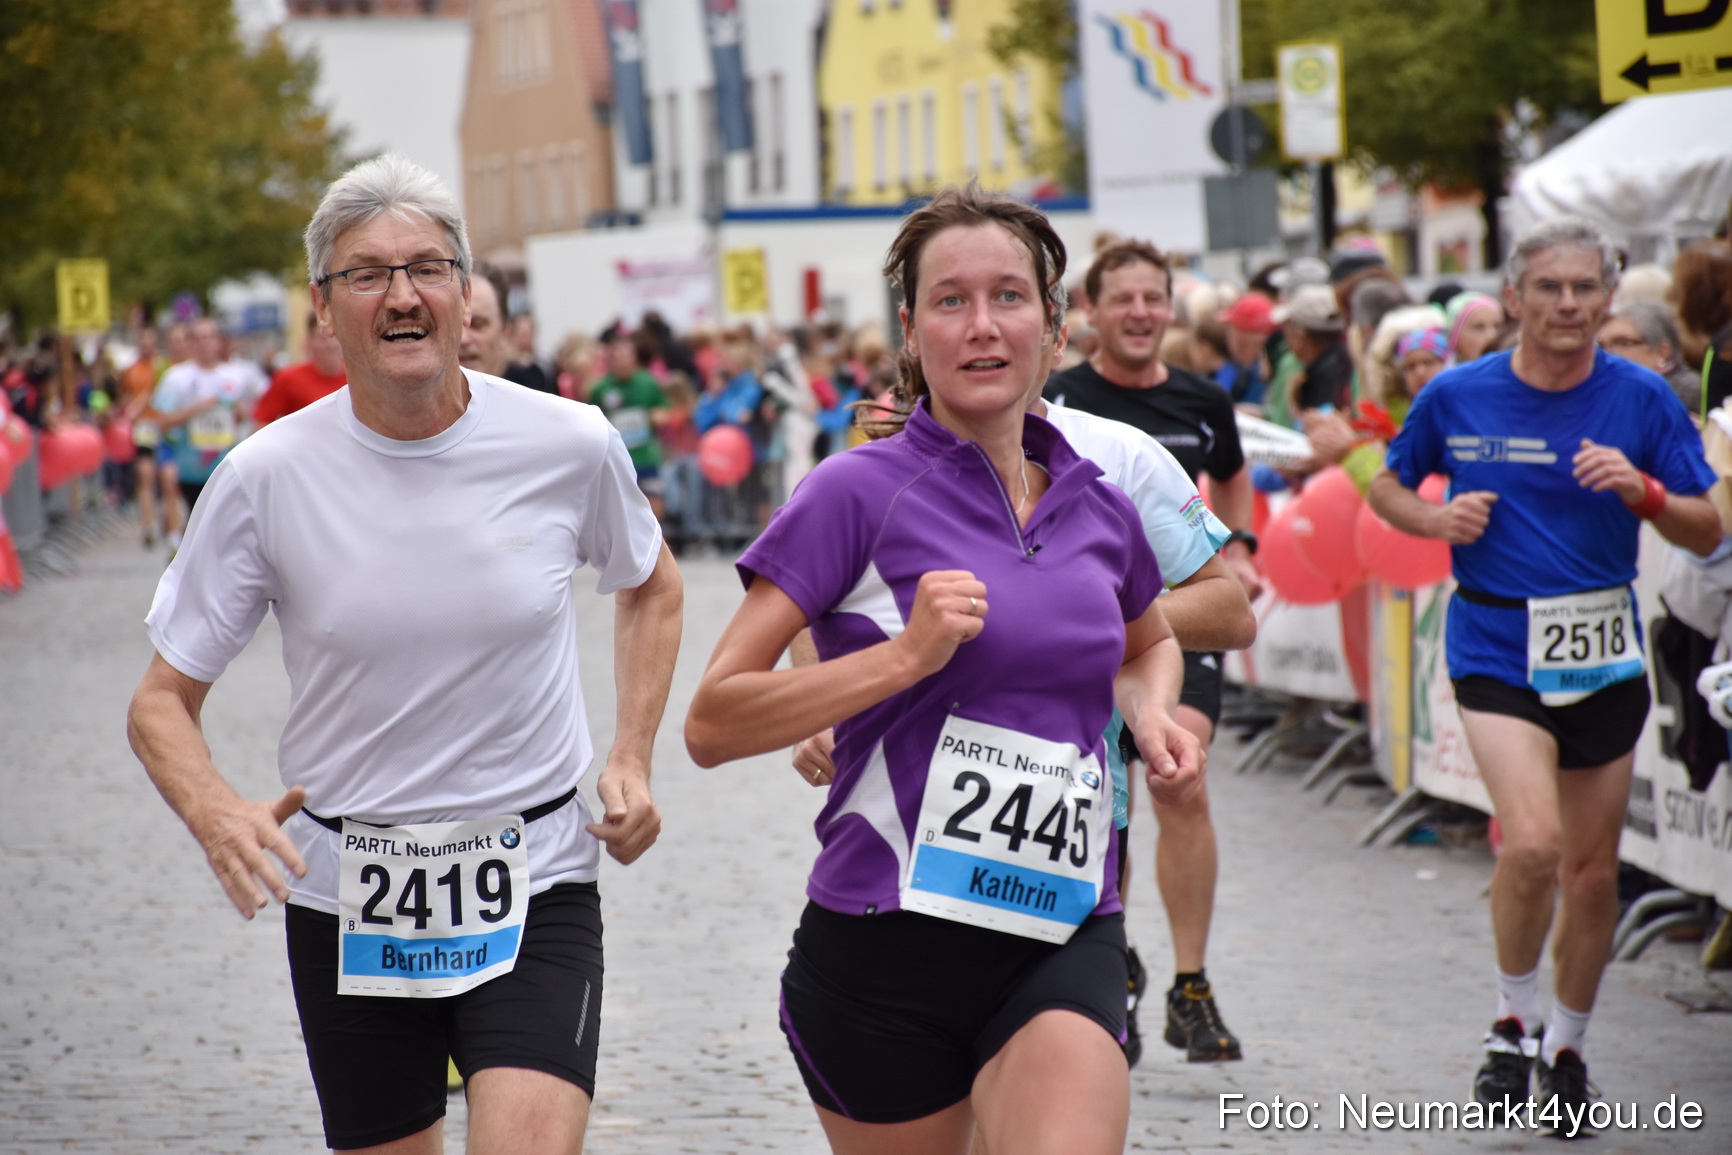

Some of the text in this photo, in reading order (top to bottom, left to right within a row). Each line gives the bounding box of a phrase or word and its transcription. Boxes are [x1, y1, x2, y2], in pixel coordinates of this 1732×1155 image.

[1543, 616, 1626, 662] 2518
[941, 735, 1008, 767] PARTL
[942, 770, 1092, 868] 2445
[345, 834, 493, 857] PARTL Neumarkt
[926, 830, 935, 843] D
[360, 859, 512, 930] 2419
[969, 866, 1057, 912] Kathrin
[348, 920, 355, 931] B
[381, 942, 488, 972] Bernhard
